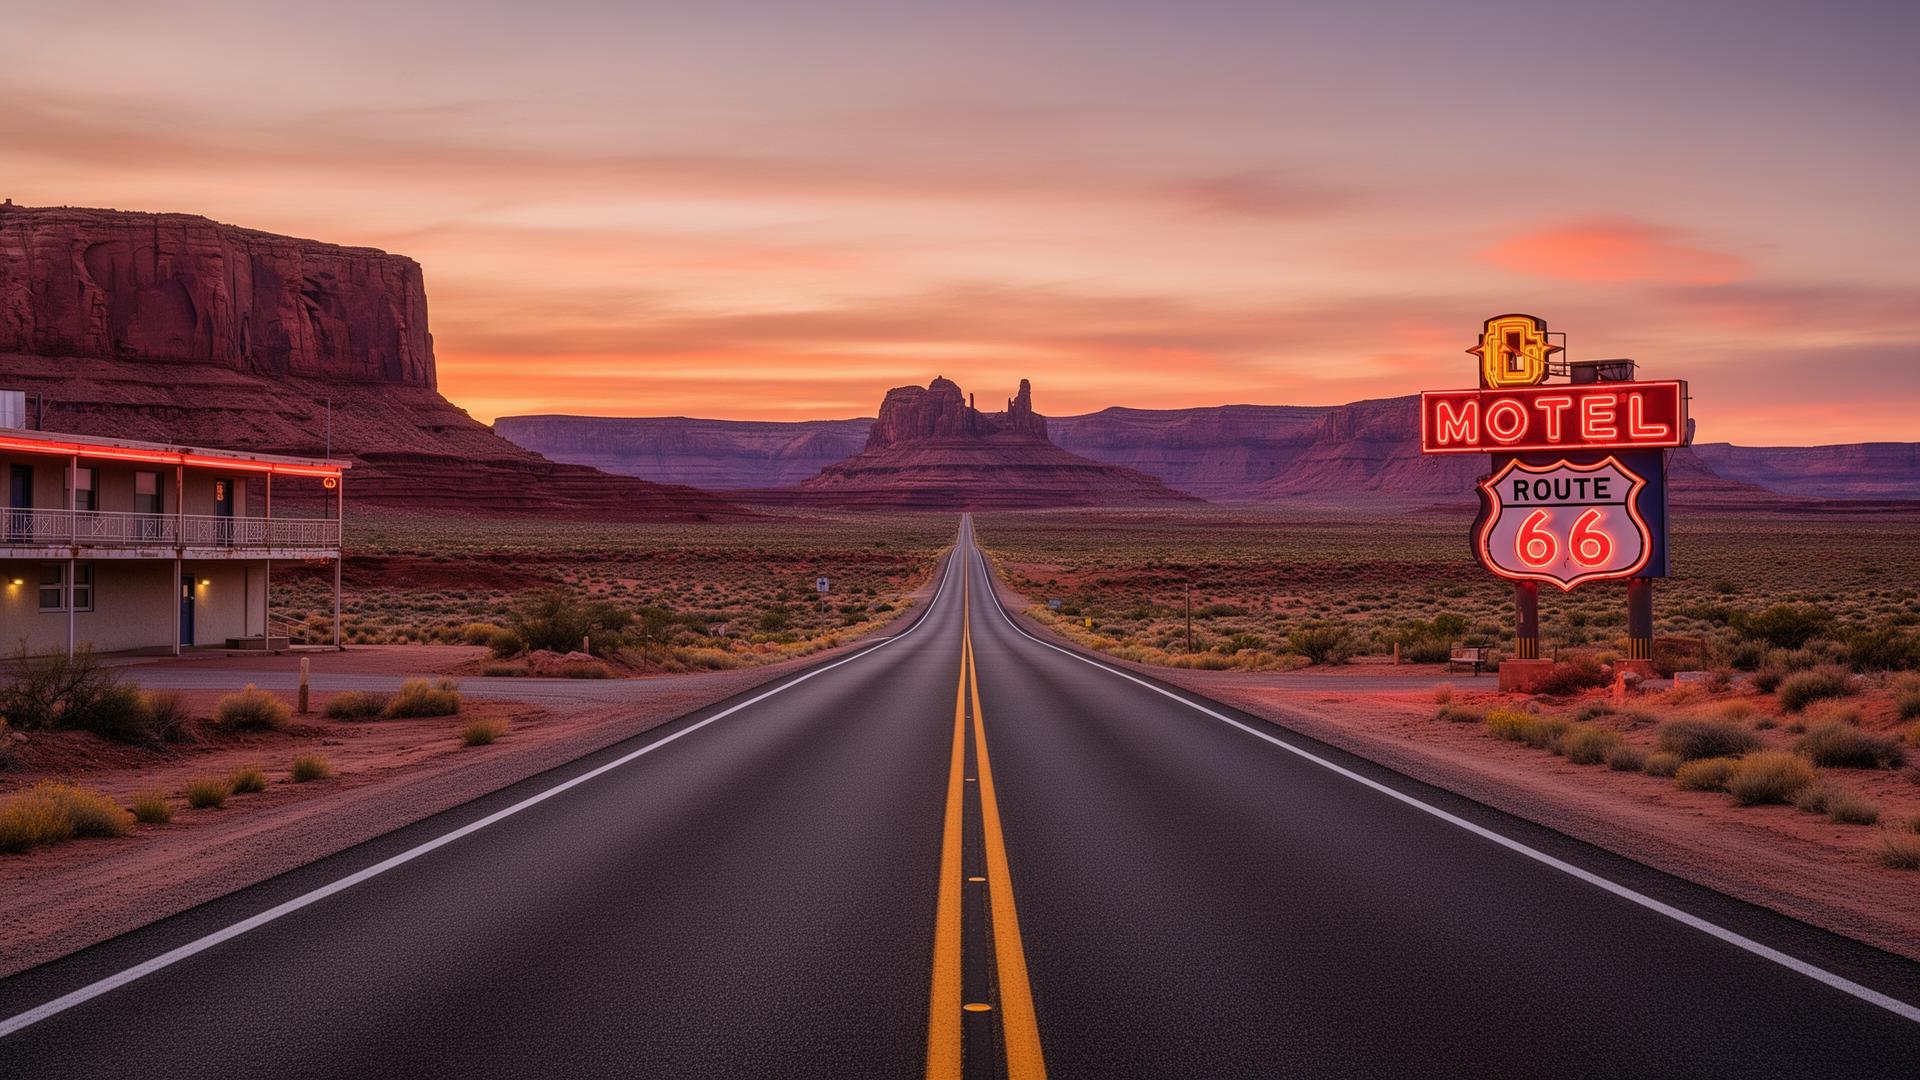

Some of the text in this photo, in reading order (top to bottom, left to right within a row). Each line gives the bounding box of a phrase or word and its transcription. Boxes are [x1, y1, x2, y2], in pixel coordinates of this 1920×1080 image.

[1436, 395, 1668, 443] MOTEL
[1513, 477, 1611, 501] ROUTE
[1517, 508, 1612, 568] 66
